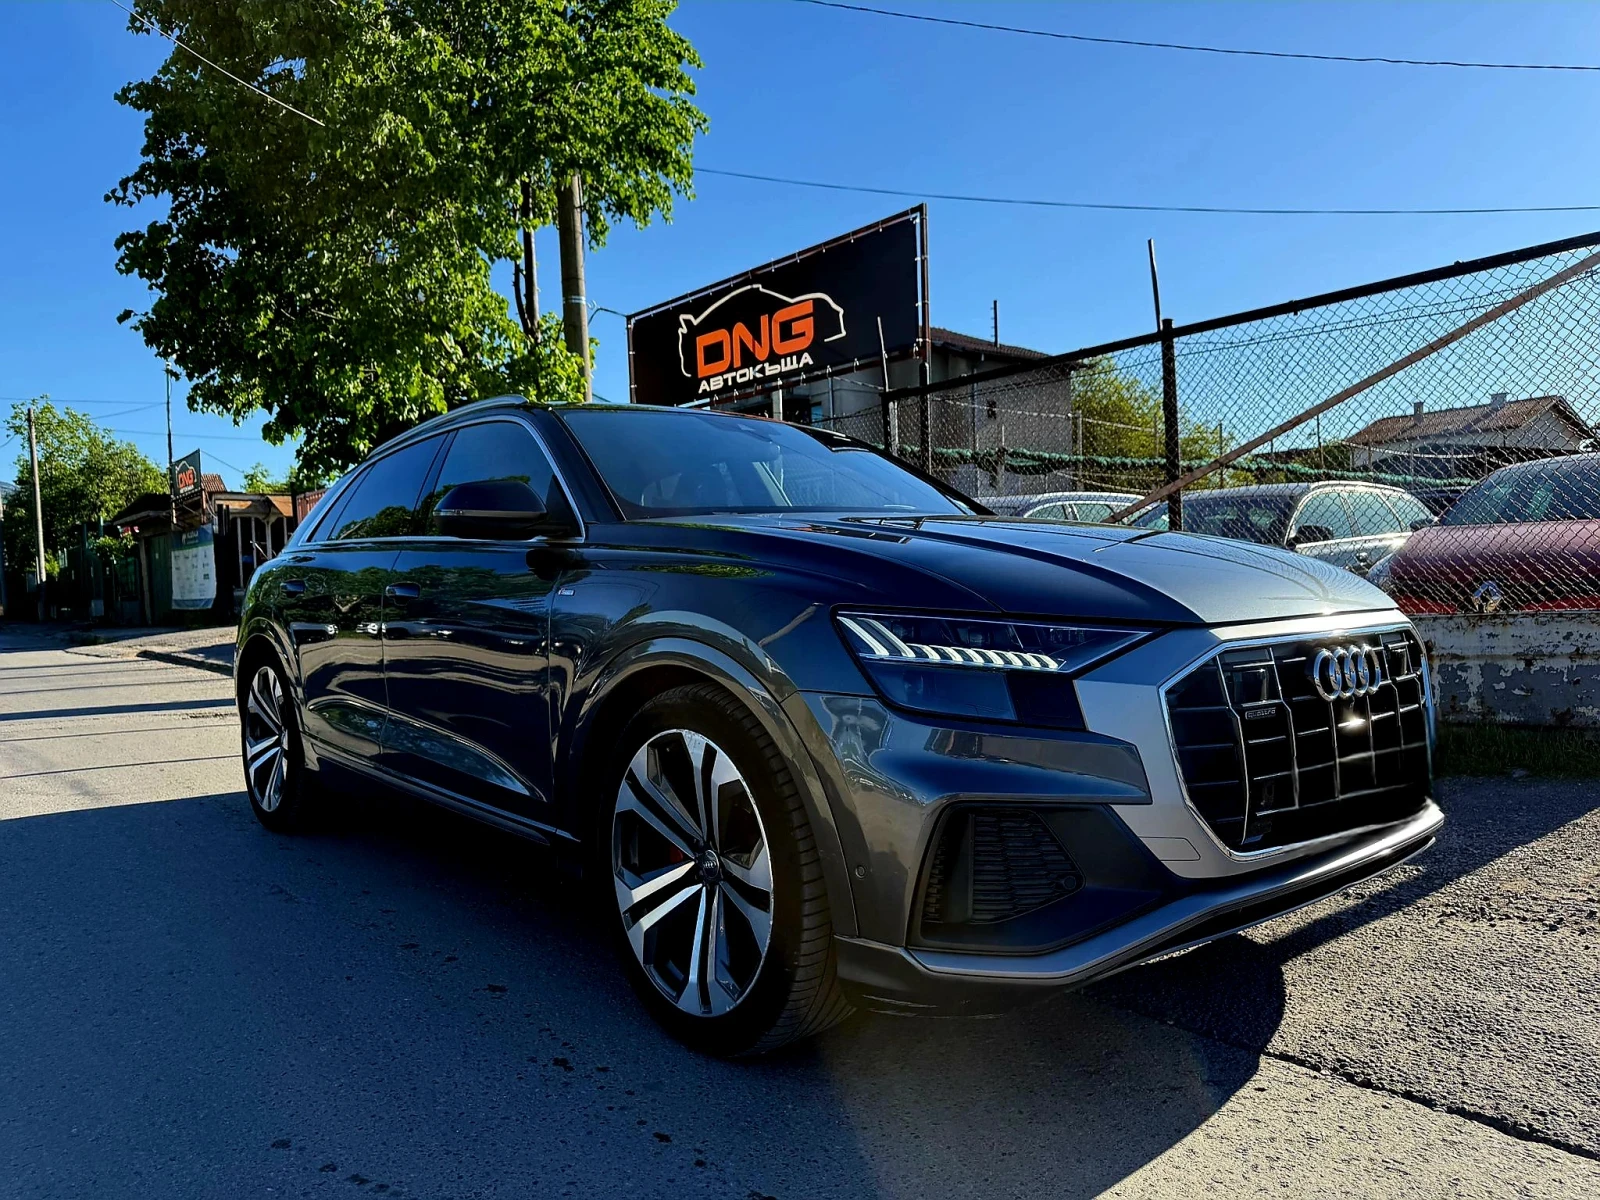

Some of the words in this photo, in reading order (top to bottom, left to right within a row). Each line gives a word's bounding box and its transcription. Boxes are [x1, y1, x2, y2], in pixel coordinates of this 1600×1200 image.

[696, 299, 814, 379] DNG
[698, 352, 814, 394] АВТОКЪЩА
[178, 468, 194, 489] DNG
[1247, 708, 1276, 719] quattro
